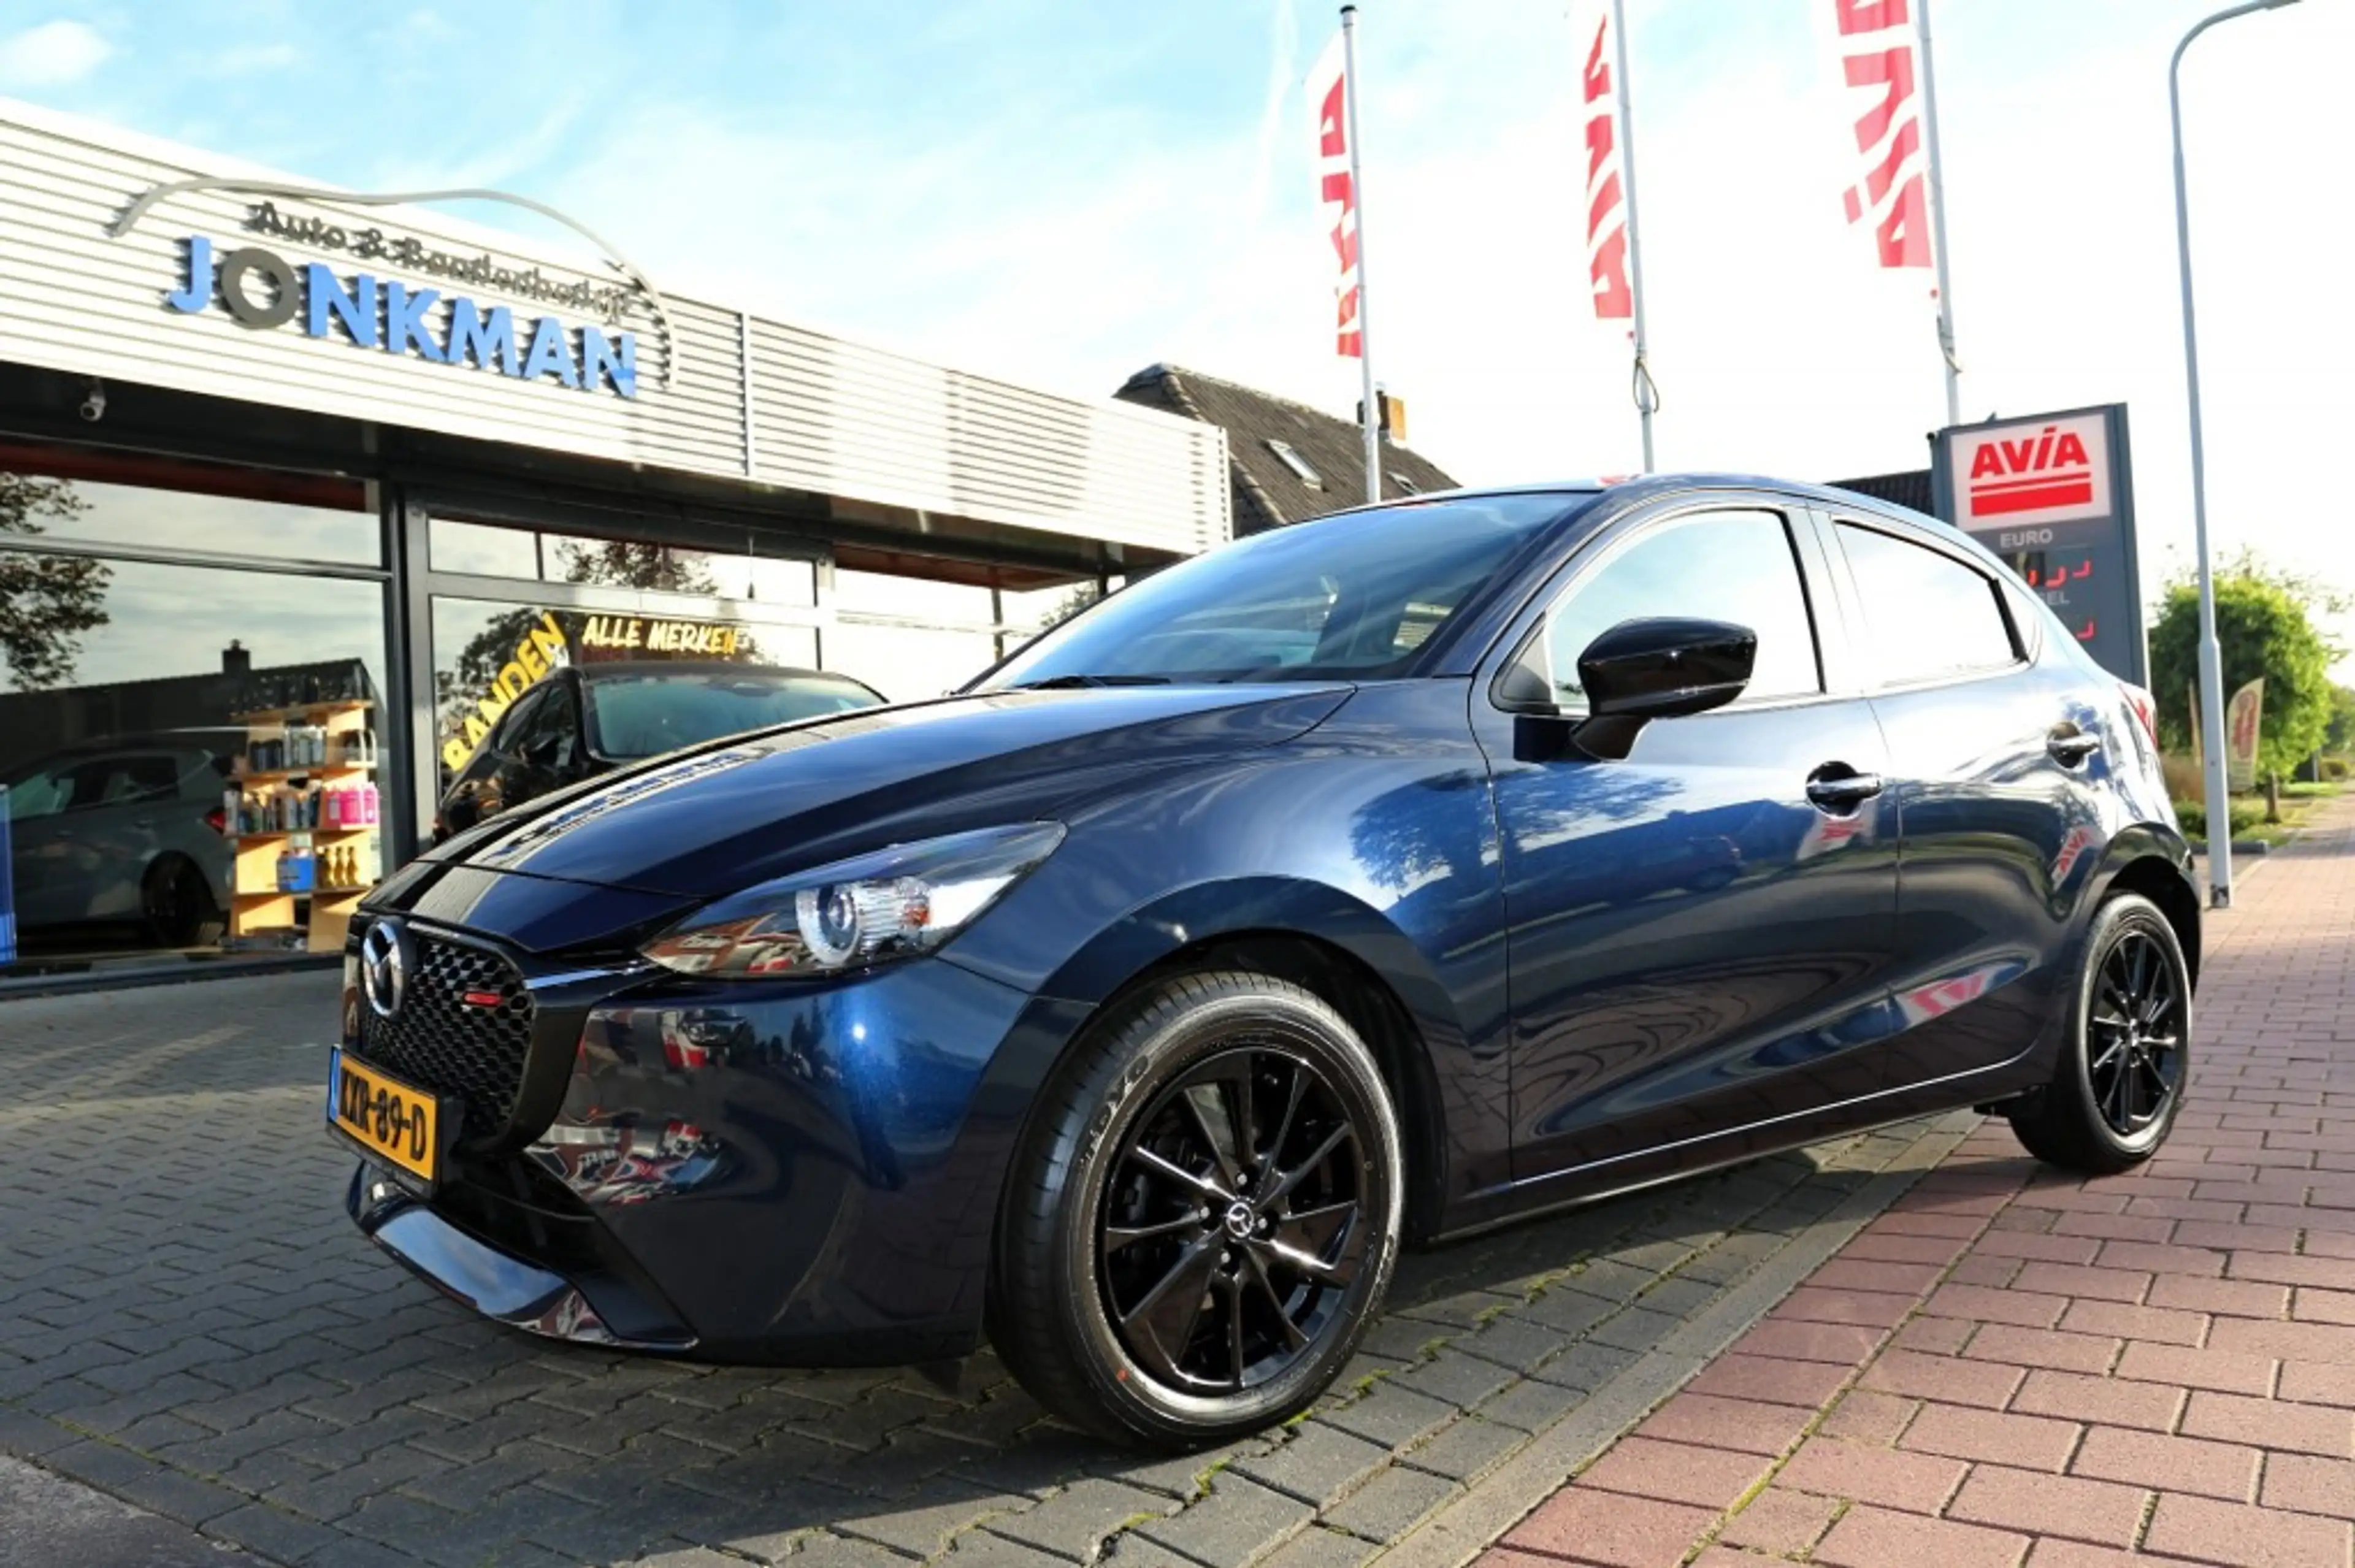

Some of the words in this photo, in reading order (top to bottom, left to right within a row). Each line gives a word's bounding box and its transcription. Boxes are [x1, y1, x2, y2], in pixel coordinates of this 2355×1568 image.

[251, 201, 347, 250] Auto
[361, 228, 390, 260] &
[169, 234, 637, 399] JONKMAN
[2000, 528, 2053, 548] EURO
[581, 616, 643, 648] ALLE
[646, 622, 737, 655] MERKEN
[442, 612, 569, 773] BANDEN
